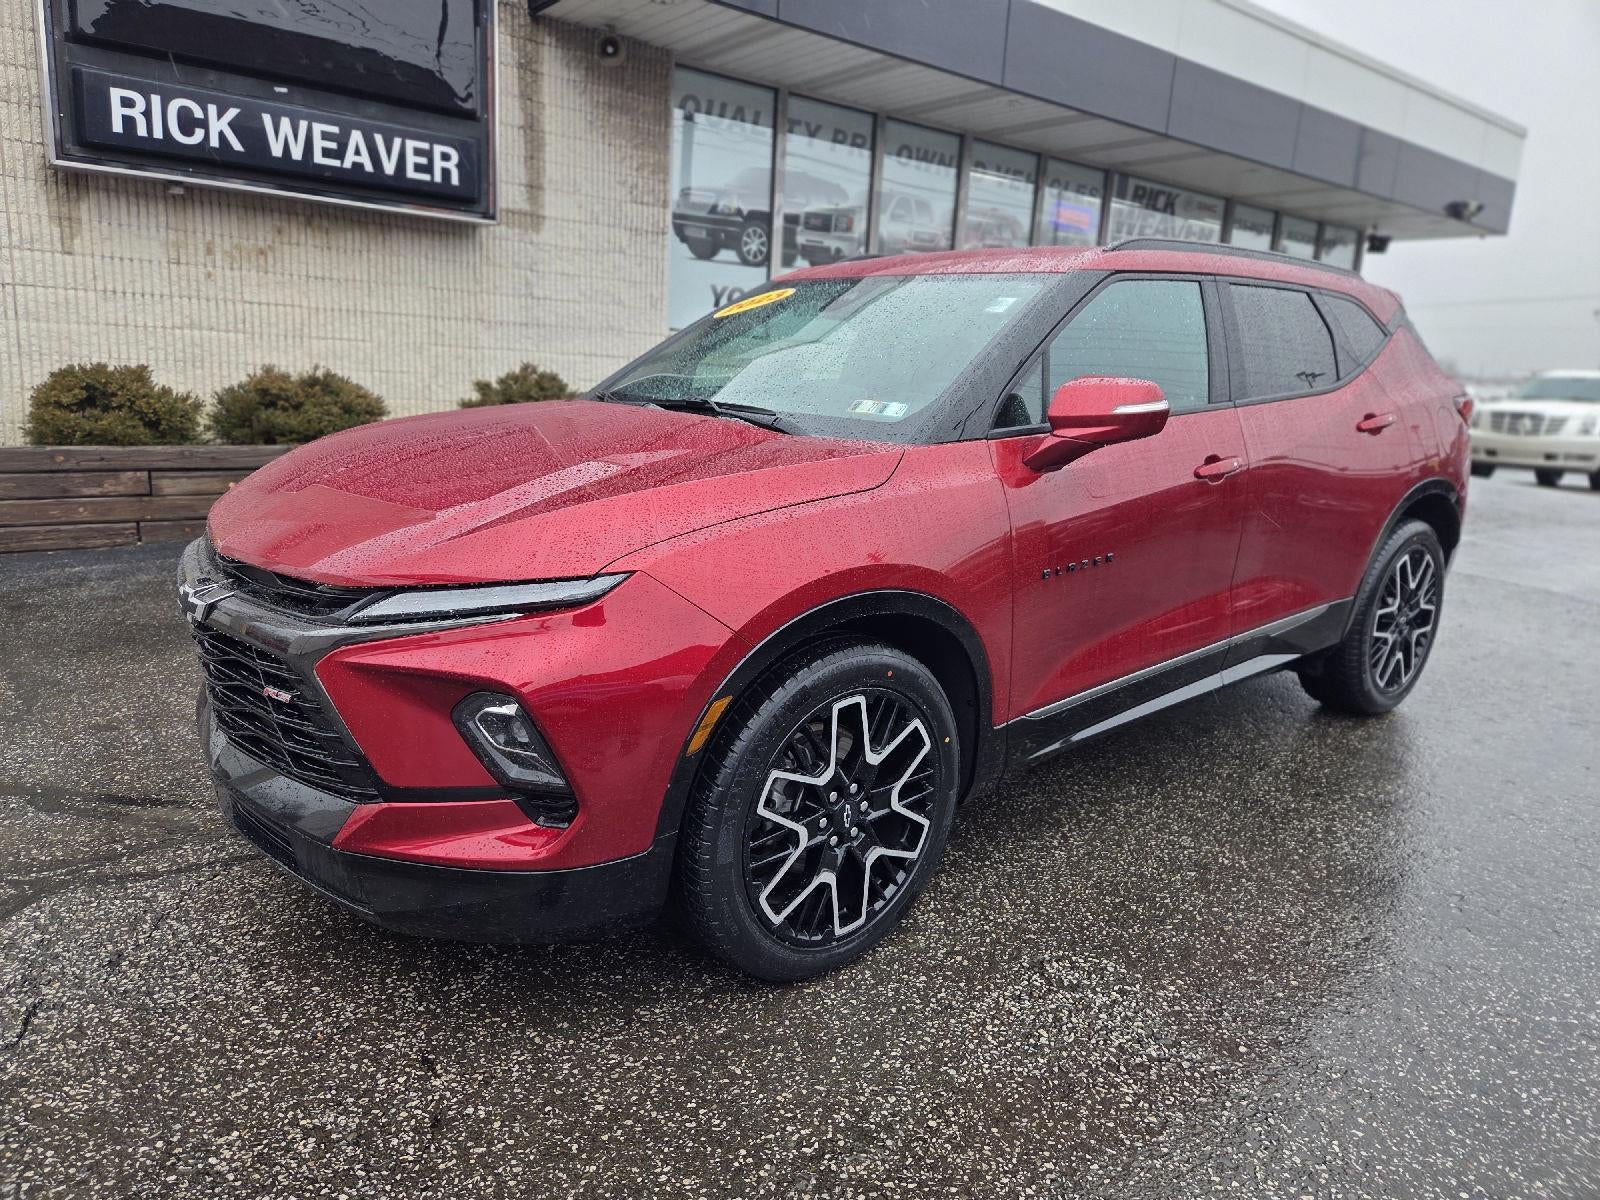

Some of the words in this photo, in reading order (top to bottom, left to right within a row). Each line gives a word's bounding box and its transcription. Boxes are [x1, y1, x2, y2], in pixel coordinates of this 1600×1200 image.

[109, 87, 245, 152] RICK
[262, 113, 460, 186] WEAVER
[1132, 184, 1180, 215] RICK
[1042, 552, 1114, 579] BLAZER
